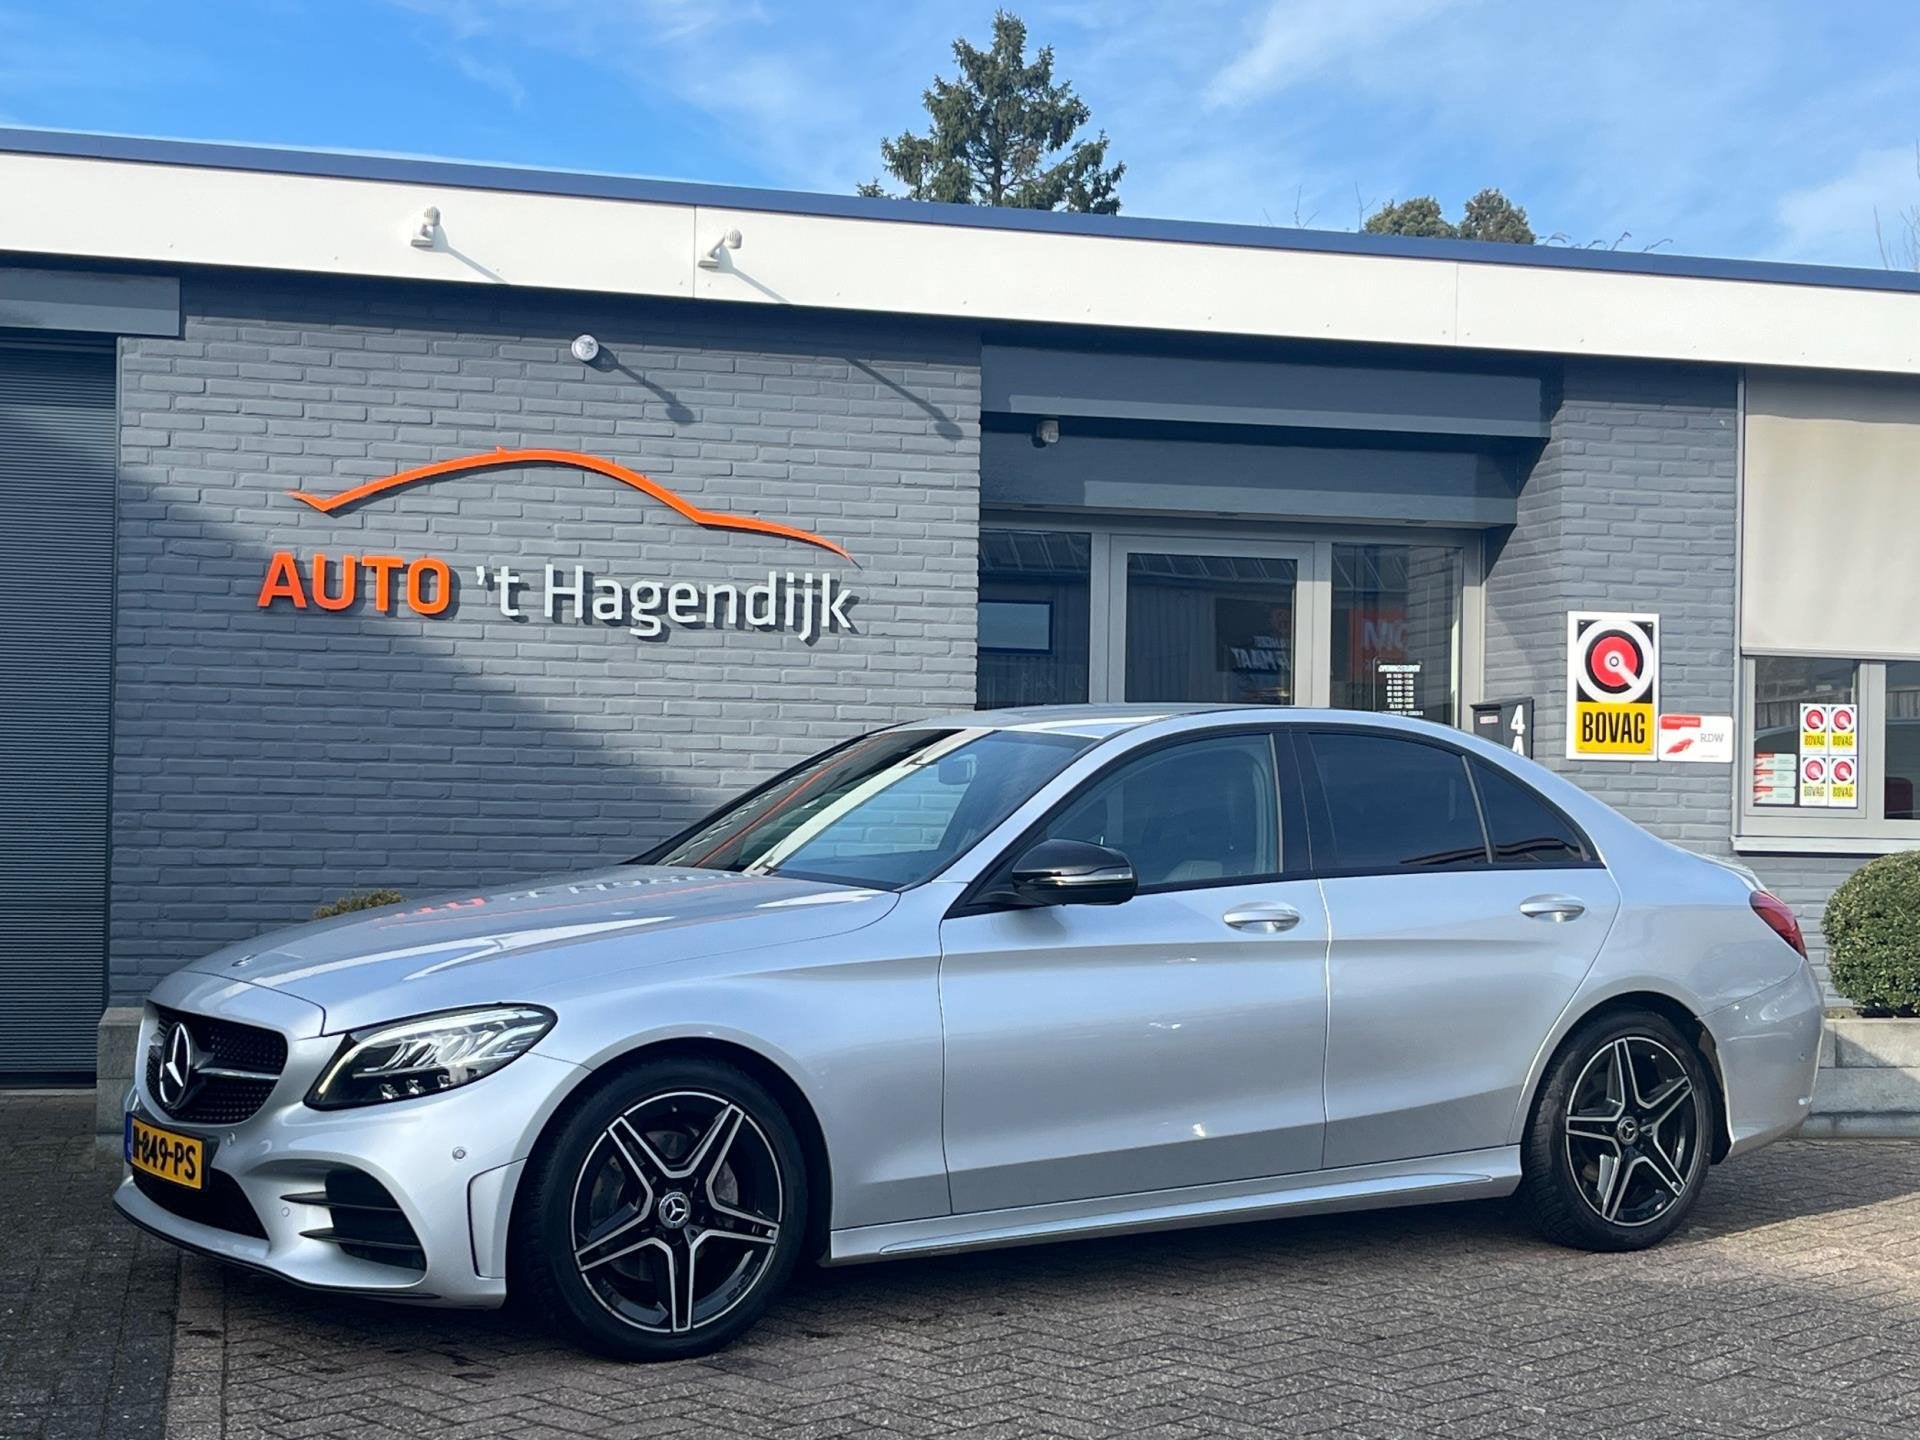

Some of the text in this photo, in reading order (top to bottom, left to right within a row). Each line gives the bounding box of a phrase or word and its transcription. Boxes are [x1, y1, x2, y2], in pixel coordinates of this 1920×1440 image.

[257, 551, 451, 616] AUTO
[543, 563, 854, 642] Hagendijk
[1510, 704, 1526, 735] 4
[1582, 711, 1646, 744] BOVAG
[1699, 732, 1725, 744] RDW
